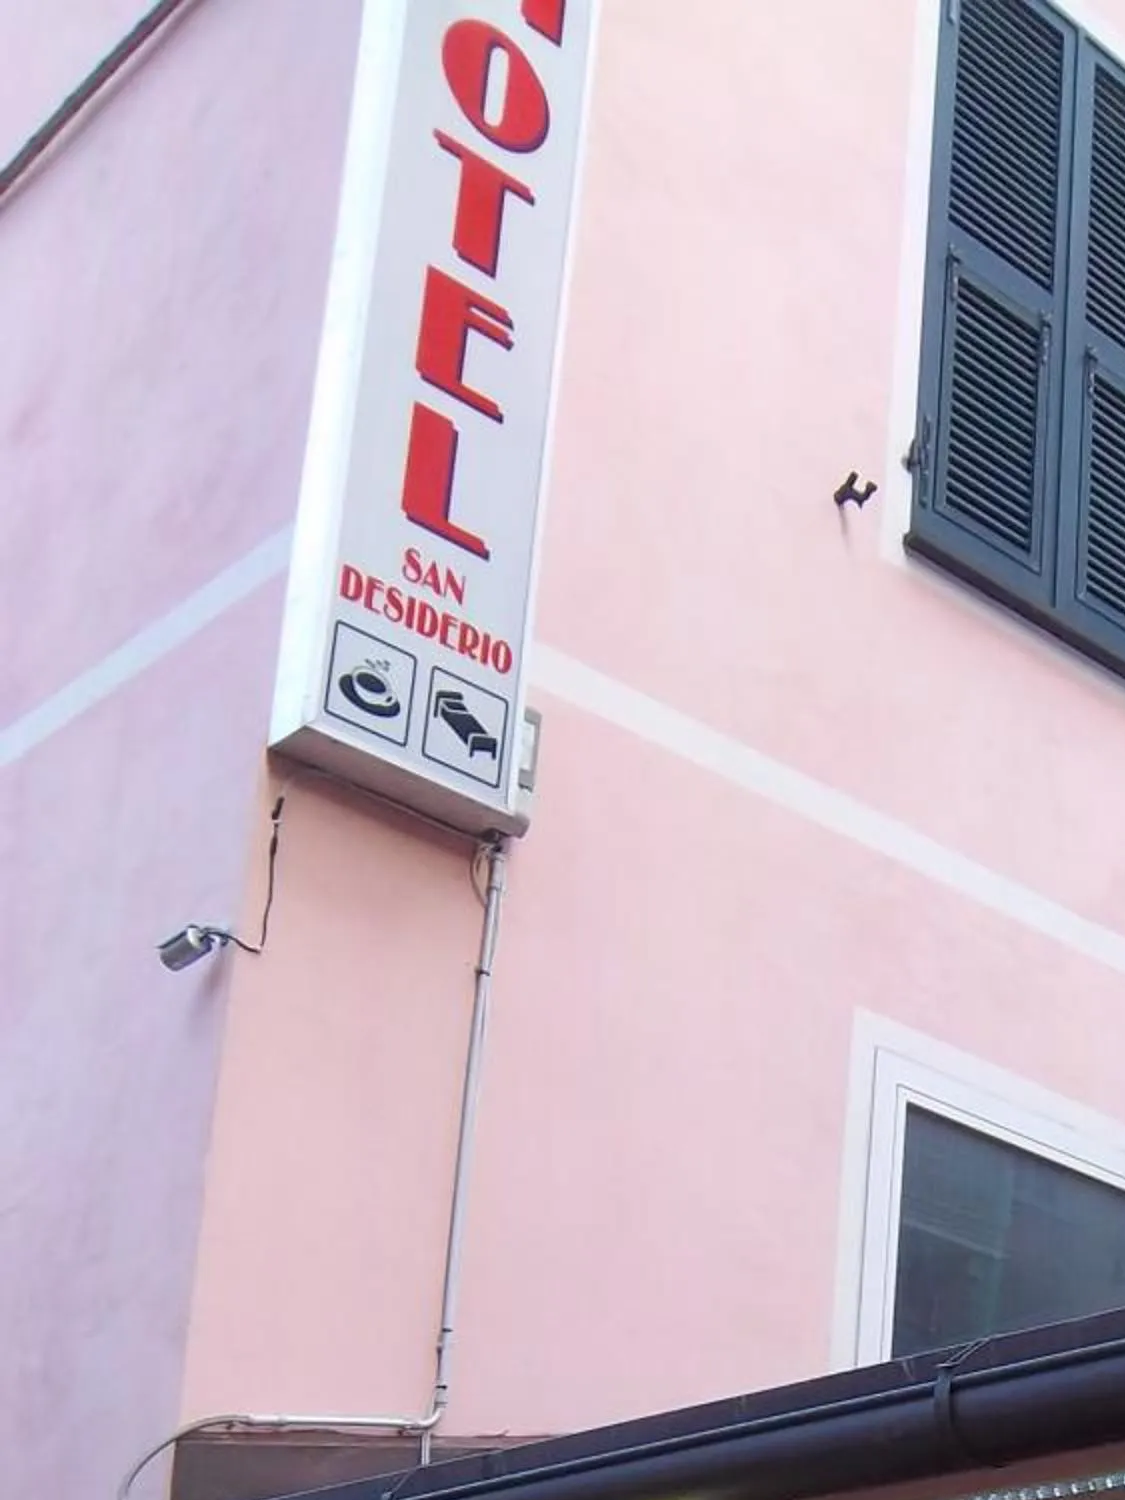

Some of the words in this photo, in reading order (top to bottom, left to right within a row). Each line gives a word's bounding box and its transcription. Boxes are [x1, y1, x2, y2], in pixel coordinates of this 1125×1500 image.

[401, 0, 567, 561] OTEL
[339, 564, 513, 674] DESIDERIO
[402, 547, 467, 606] SAN
